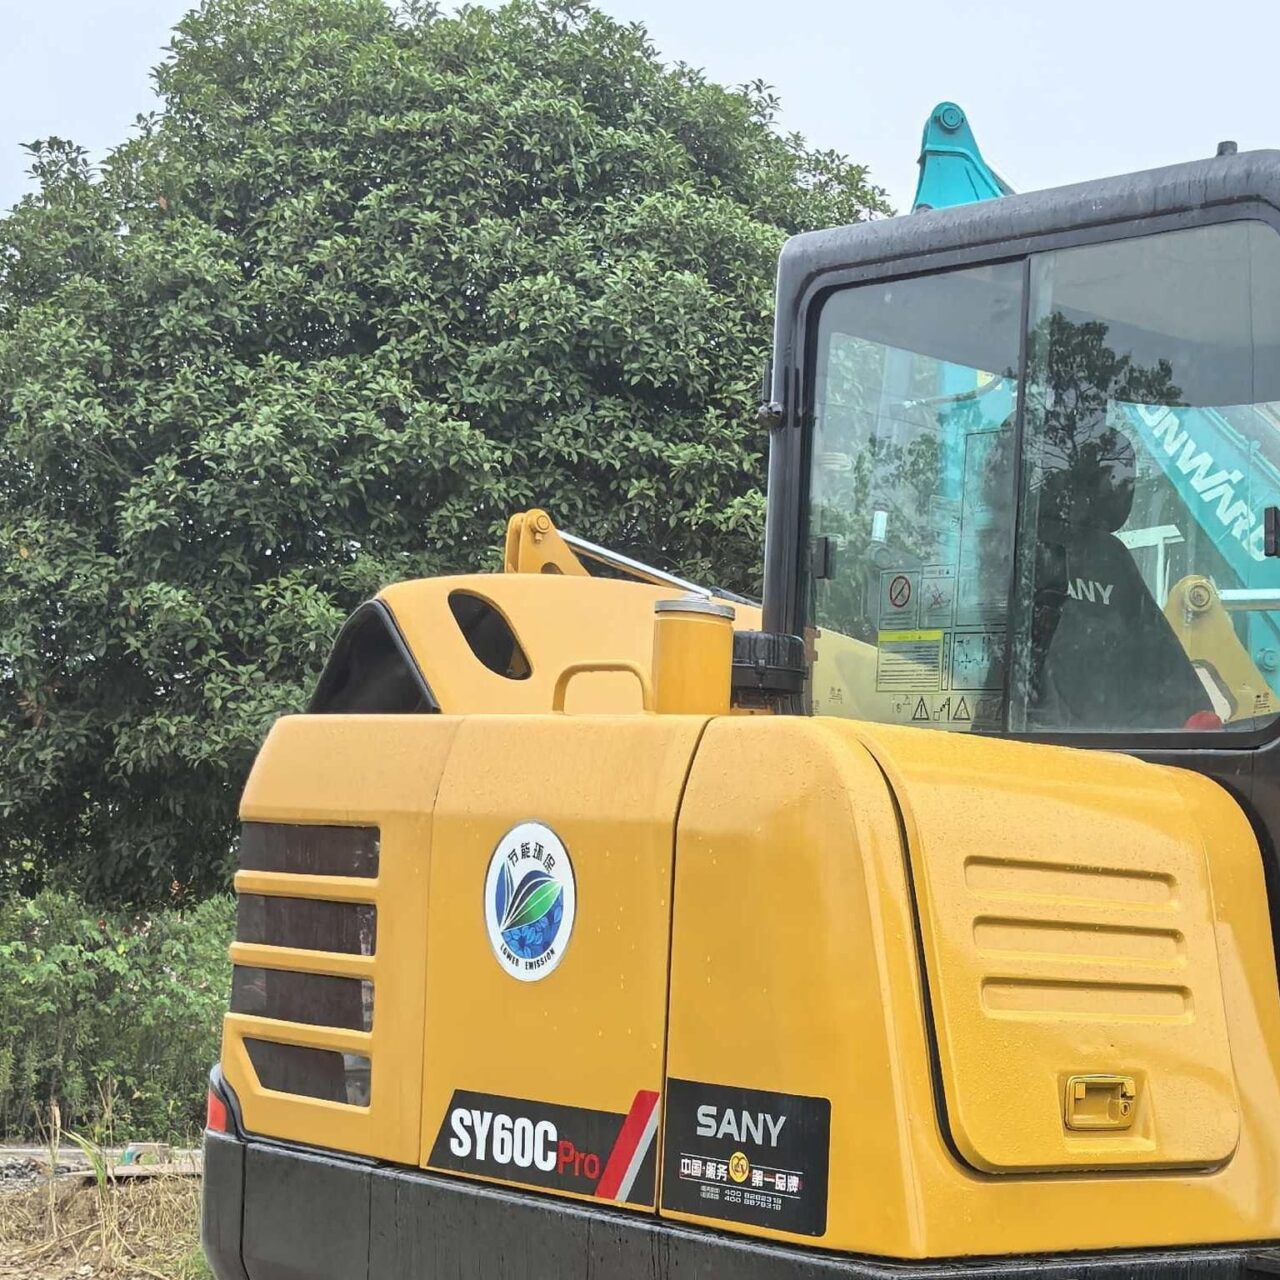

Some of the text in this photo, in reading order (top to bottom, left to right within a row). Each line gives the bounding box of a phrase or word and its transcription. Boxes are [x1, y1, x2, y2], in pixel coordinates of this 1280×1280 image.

[696, 1104, 787, 1147] SANY
[751, 1168, 800, 1193] 第一品牌
